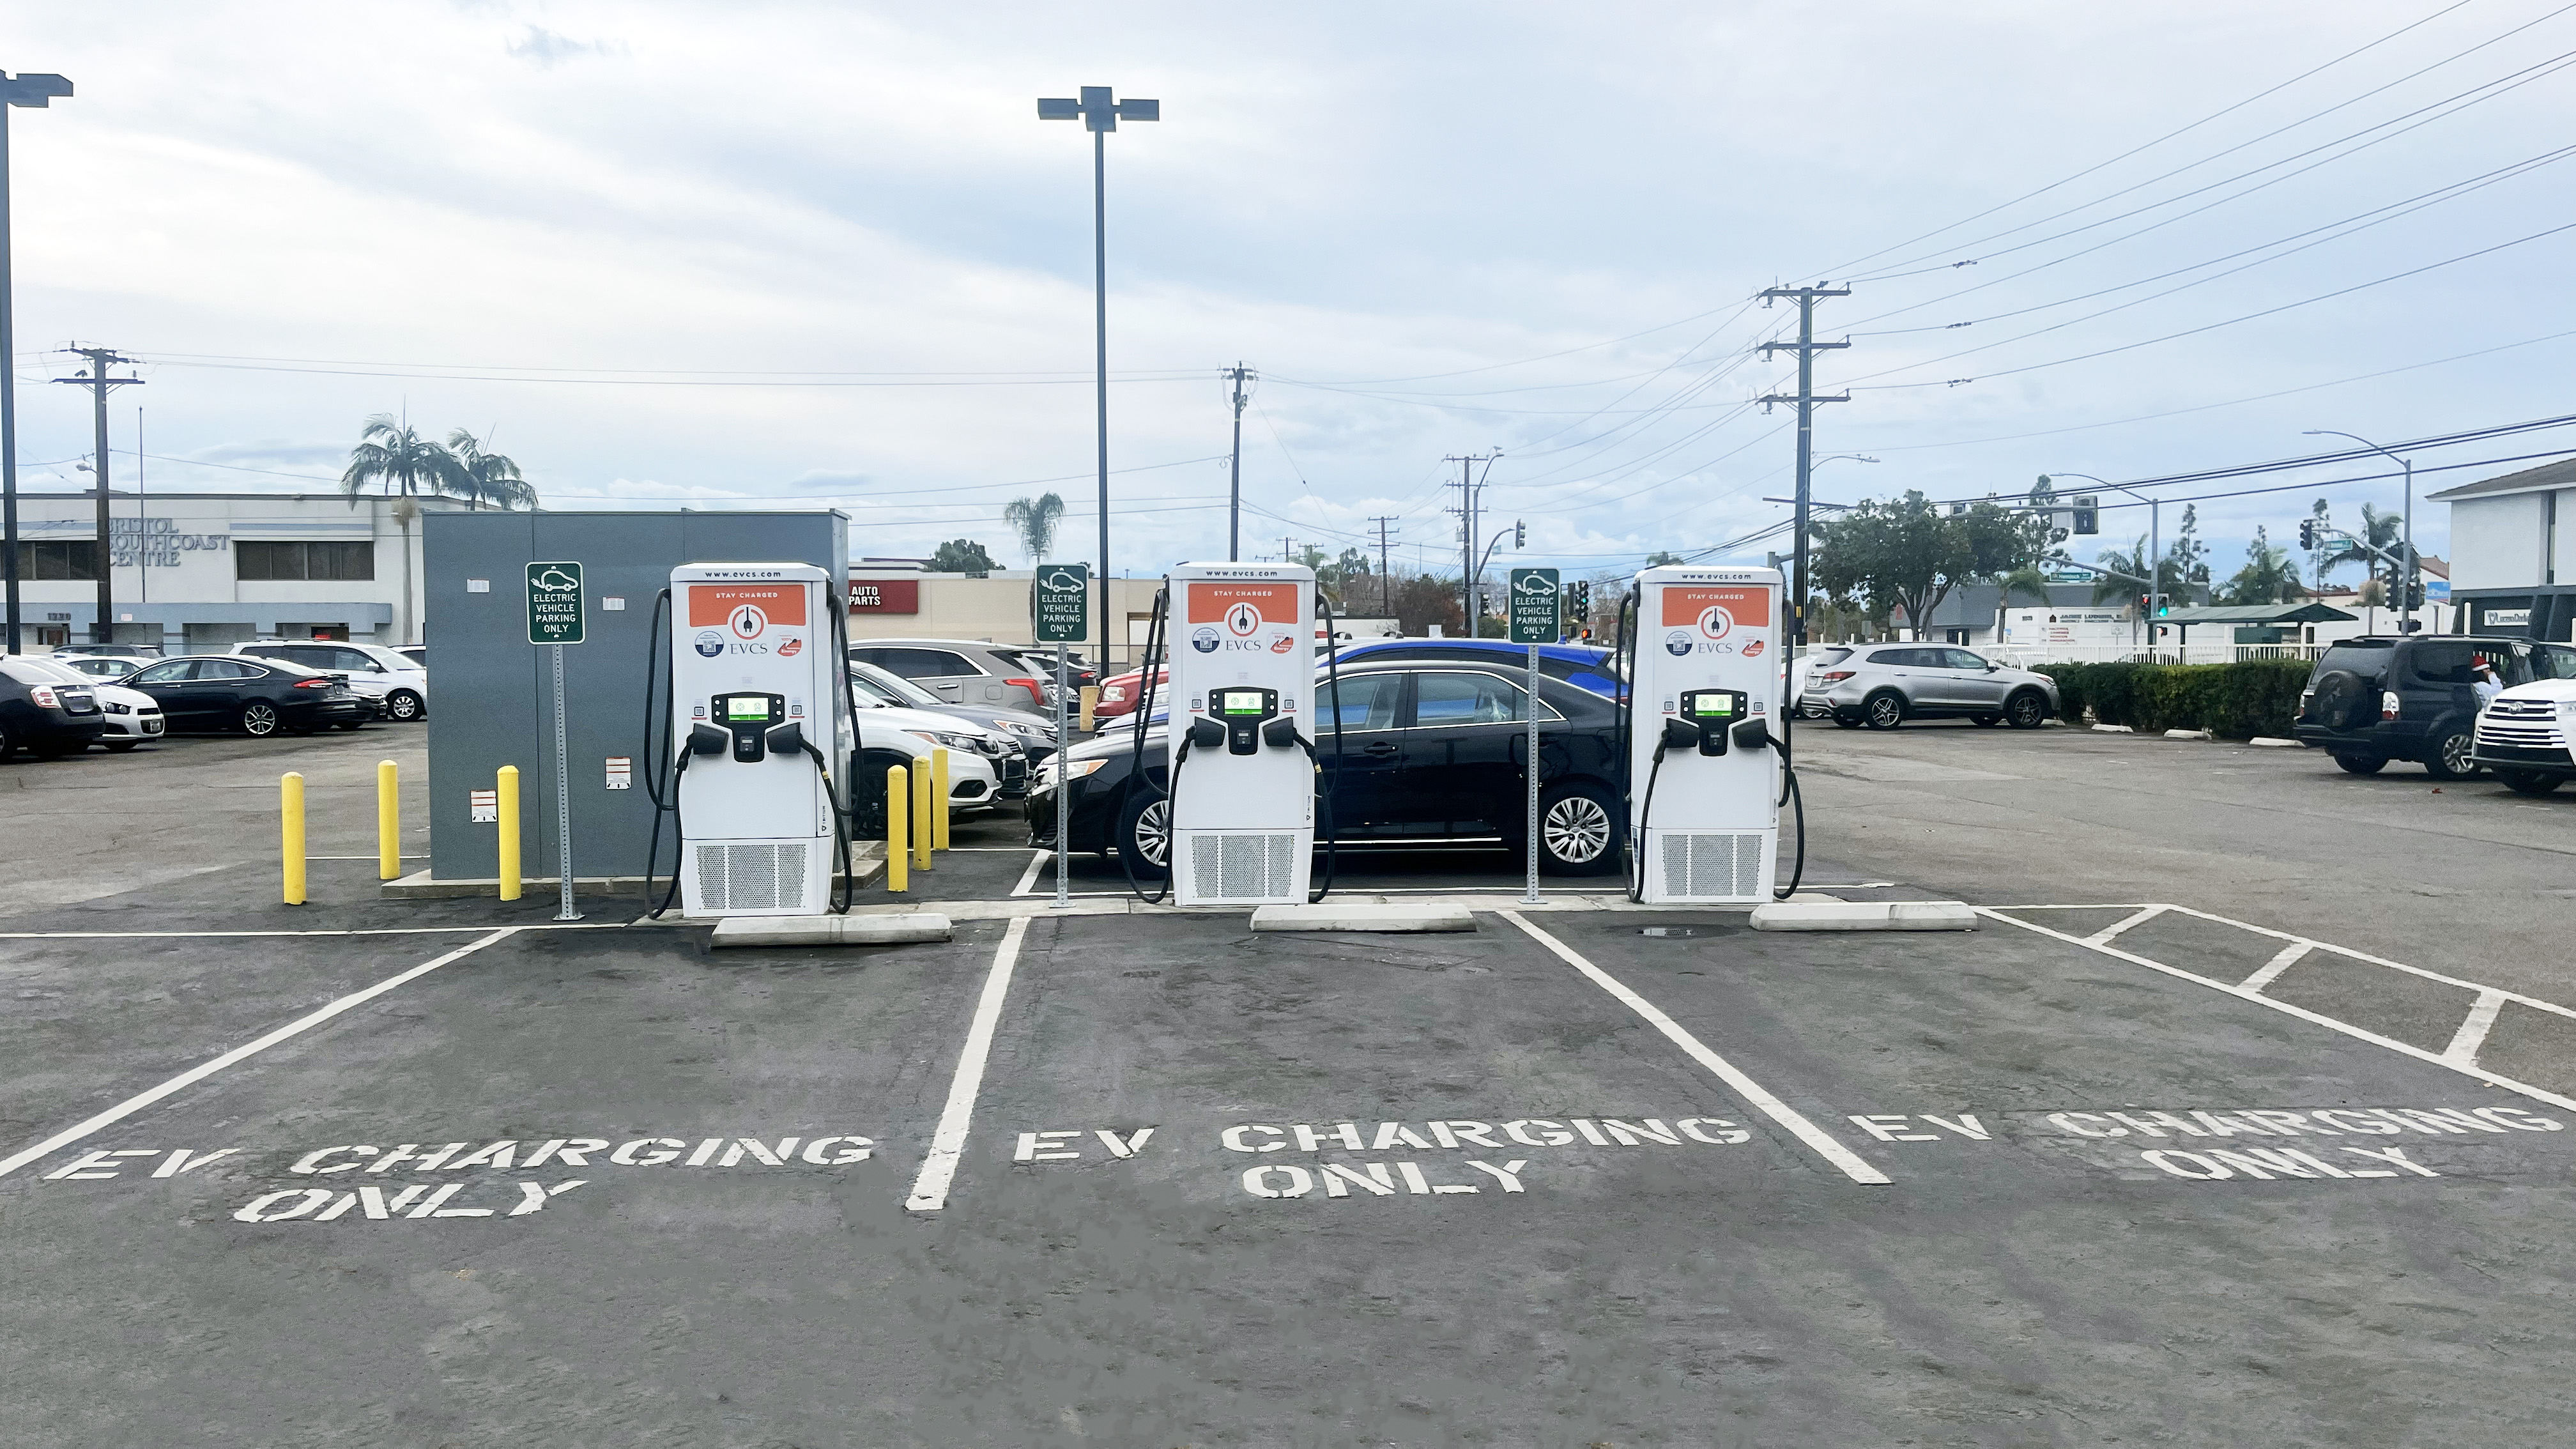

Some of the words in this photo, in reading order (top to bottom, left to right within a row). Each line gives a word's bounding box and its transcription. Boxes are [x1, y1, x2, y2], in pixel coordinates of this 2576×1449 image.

[851, 586, 878, 596] AUTO
[533, 594, 576, 602] ELECTRIC
[848, 595, 881, 606] PARTS
[1041, 594, 1082, 603] ELECTRIC
[1515, 597, 1554, 606] ELECTRIC
[536, 604, 575, 613] VEHICLE
[1043, 604, 1080, 613] VEHICLE
[1517, 607, 1552, 615] VEHICLE
[535, 614, 576, 623] PARKING
[1043, 614, 1080, 623] PARKING
[1516, 617, 1552, 625] PARKING
[544, 624, 569, 633] ONLY
[1050, 624, 1074, 632] ONLY
[1522, 626, 1546, 634] ONLY
[730, 643, 768, 655] EVCS
[1225, 640, 1261, 651] EVCS
[1698, 643, 1733, 654] EVCS
[1847, 1114, 1992, 1141] EV
[2046, 1106, 2564, 1138] CHARGING
[1014, 1128, 1156, 1161] EV
[1220, 1117, 1751, 1153] CHARGING
[43, 1148, 241, 1180] EV
[289, 1135, 875, 1174] CHARGING
[2140, 1147, 2441, 1181] ONLY
[1241, 1160, 1528, 1199] ONLY
[233, 1180, 589, 1223] ONLY
